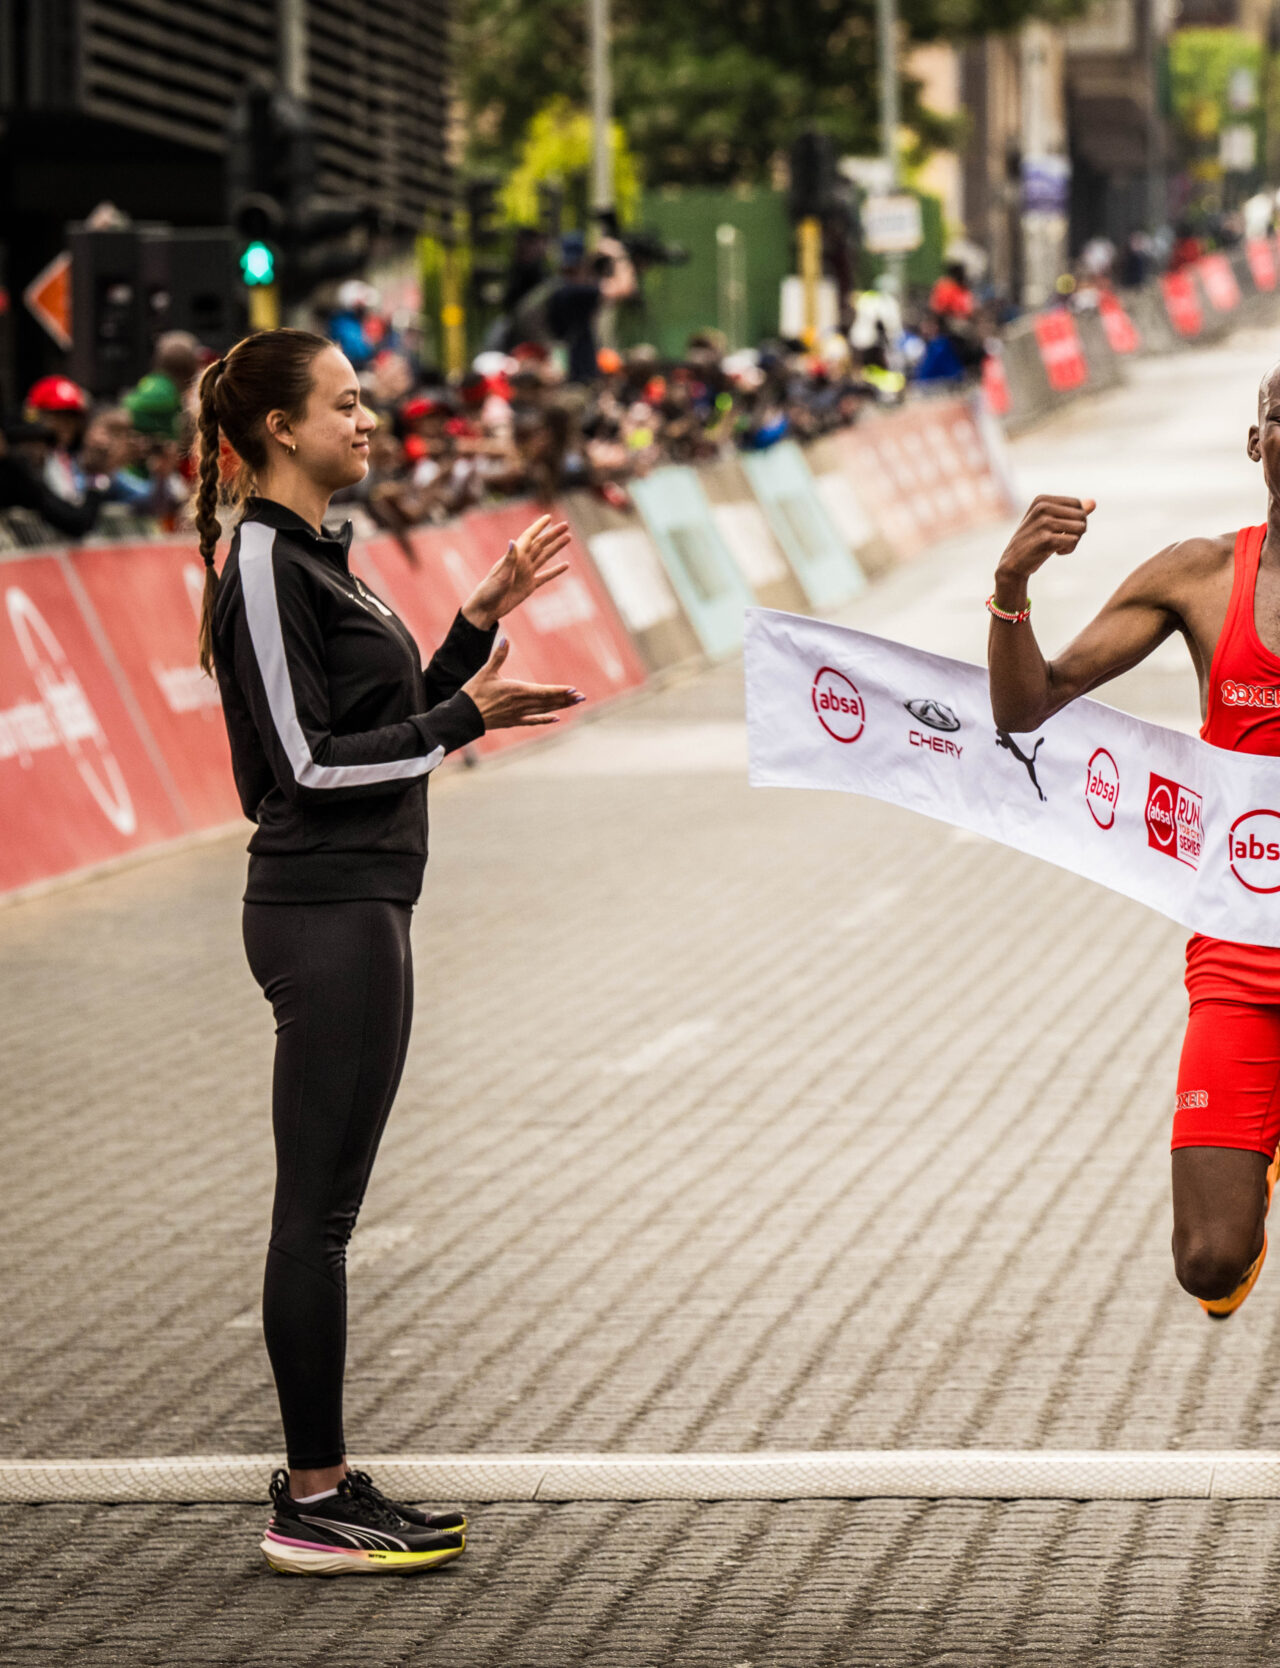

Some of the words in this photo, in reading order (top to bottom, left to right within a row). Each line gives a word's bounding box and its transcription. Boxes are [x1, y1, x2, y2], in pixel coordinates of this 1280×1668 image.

[819, 686, 859, 716] absa
[909, 730, 963, 760] CHERY
[1090, 769, 1115, 802] absa
[1150, 801, 1171, 826] absa
[1177, 796, 1200, 829] RUN
[1179, 834, 1201, 857] SERIES
